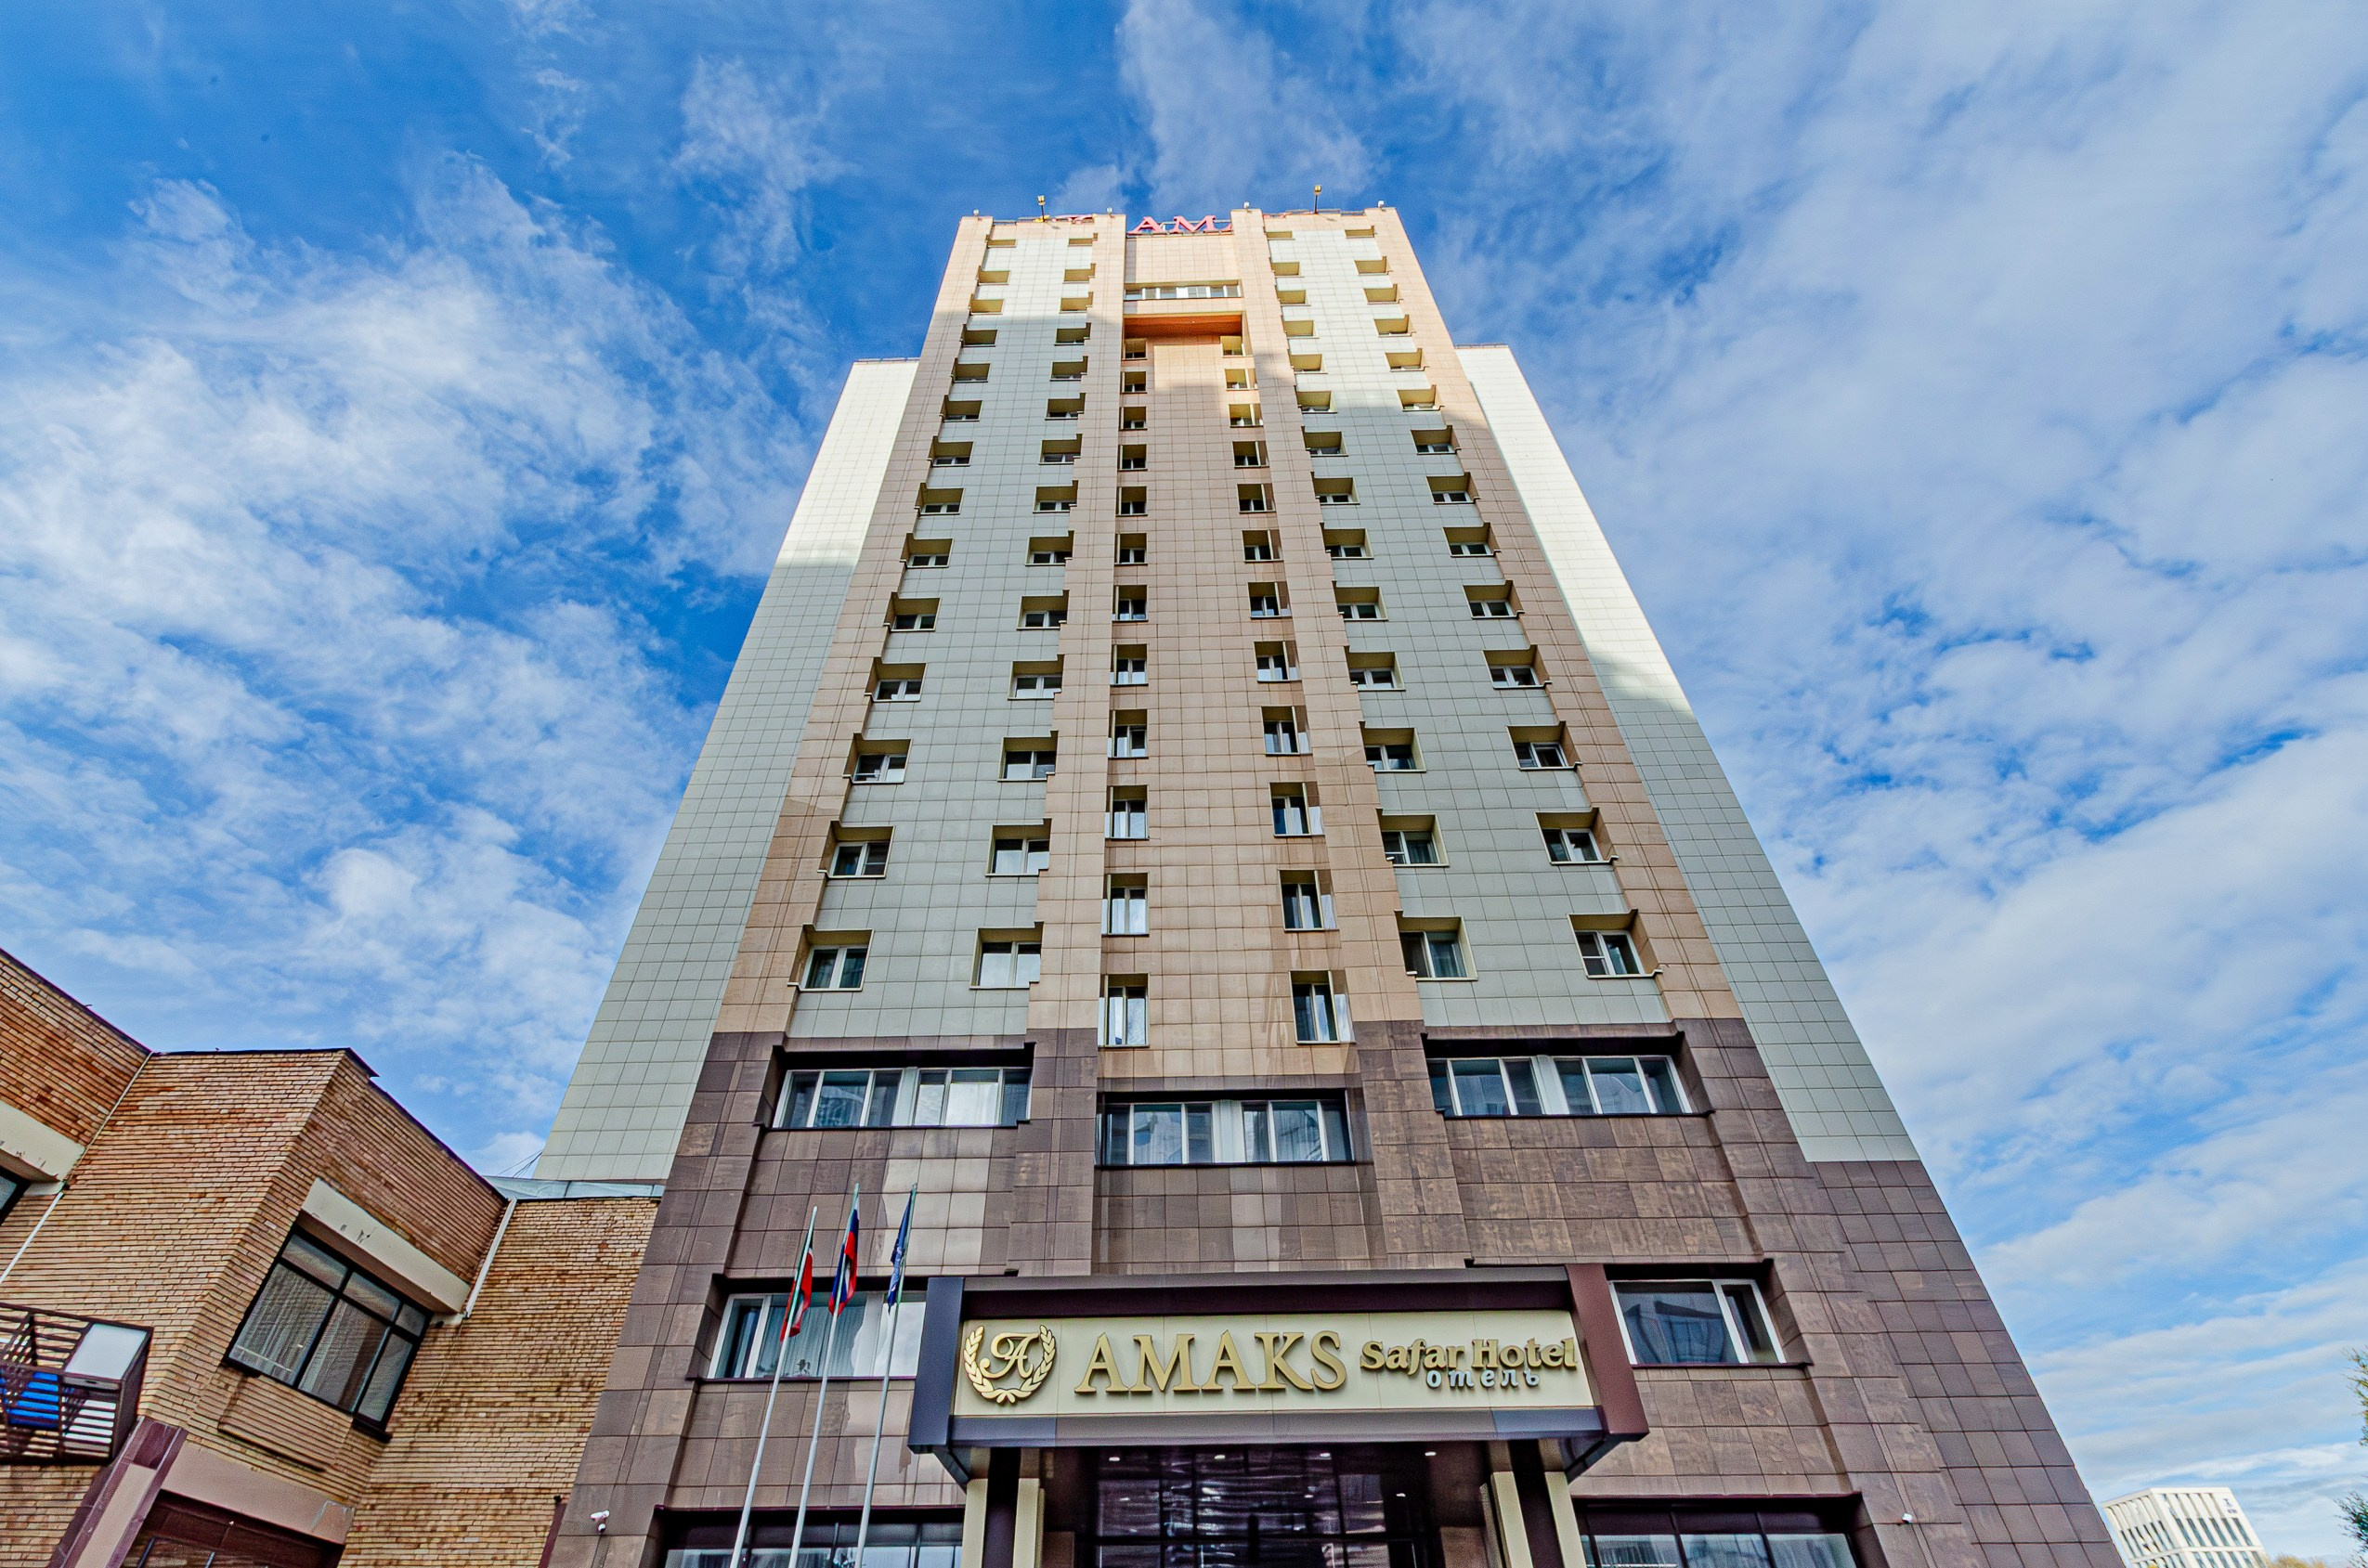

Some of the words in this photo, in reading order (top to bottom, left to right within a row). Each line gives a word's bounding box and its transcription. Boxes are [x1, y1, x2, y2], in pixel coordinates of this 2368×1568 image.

[1126, 215, 1233, 235] AM
[1073, 1329, 1347, 1393] AMAKS
[1360, 1338, 1464, 1376] Safar
[1471, 1337, 1577, 1369] Hotel
[1426, 1368, 1540, 1388] отель
